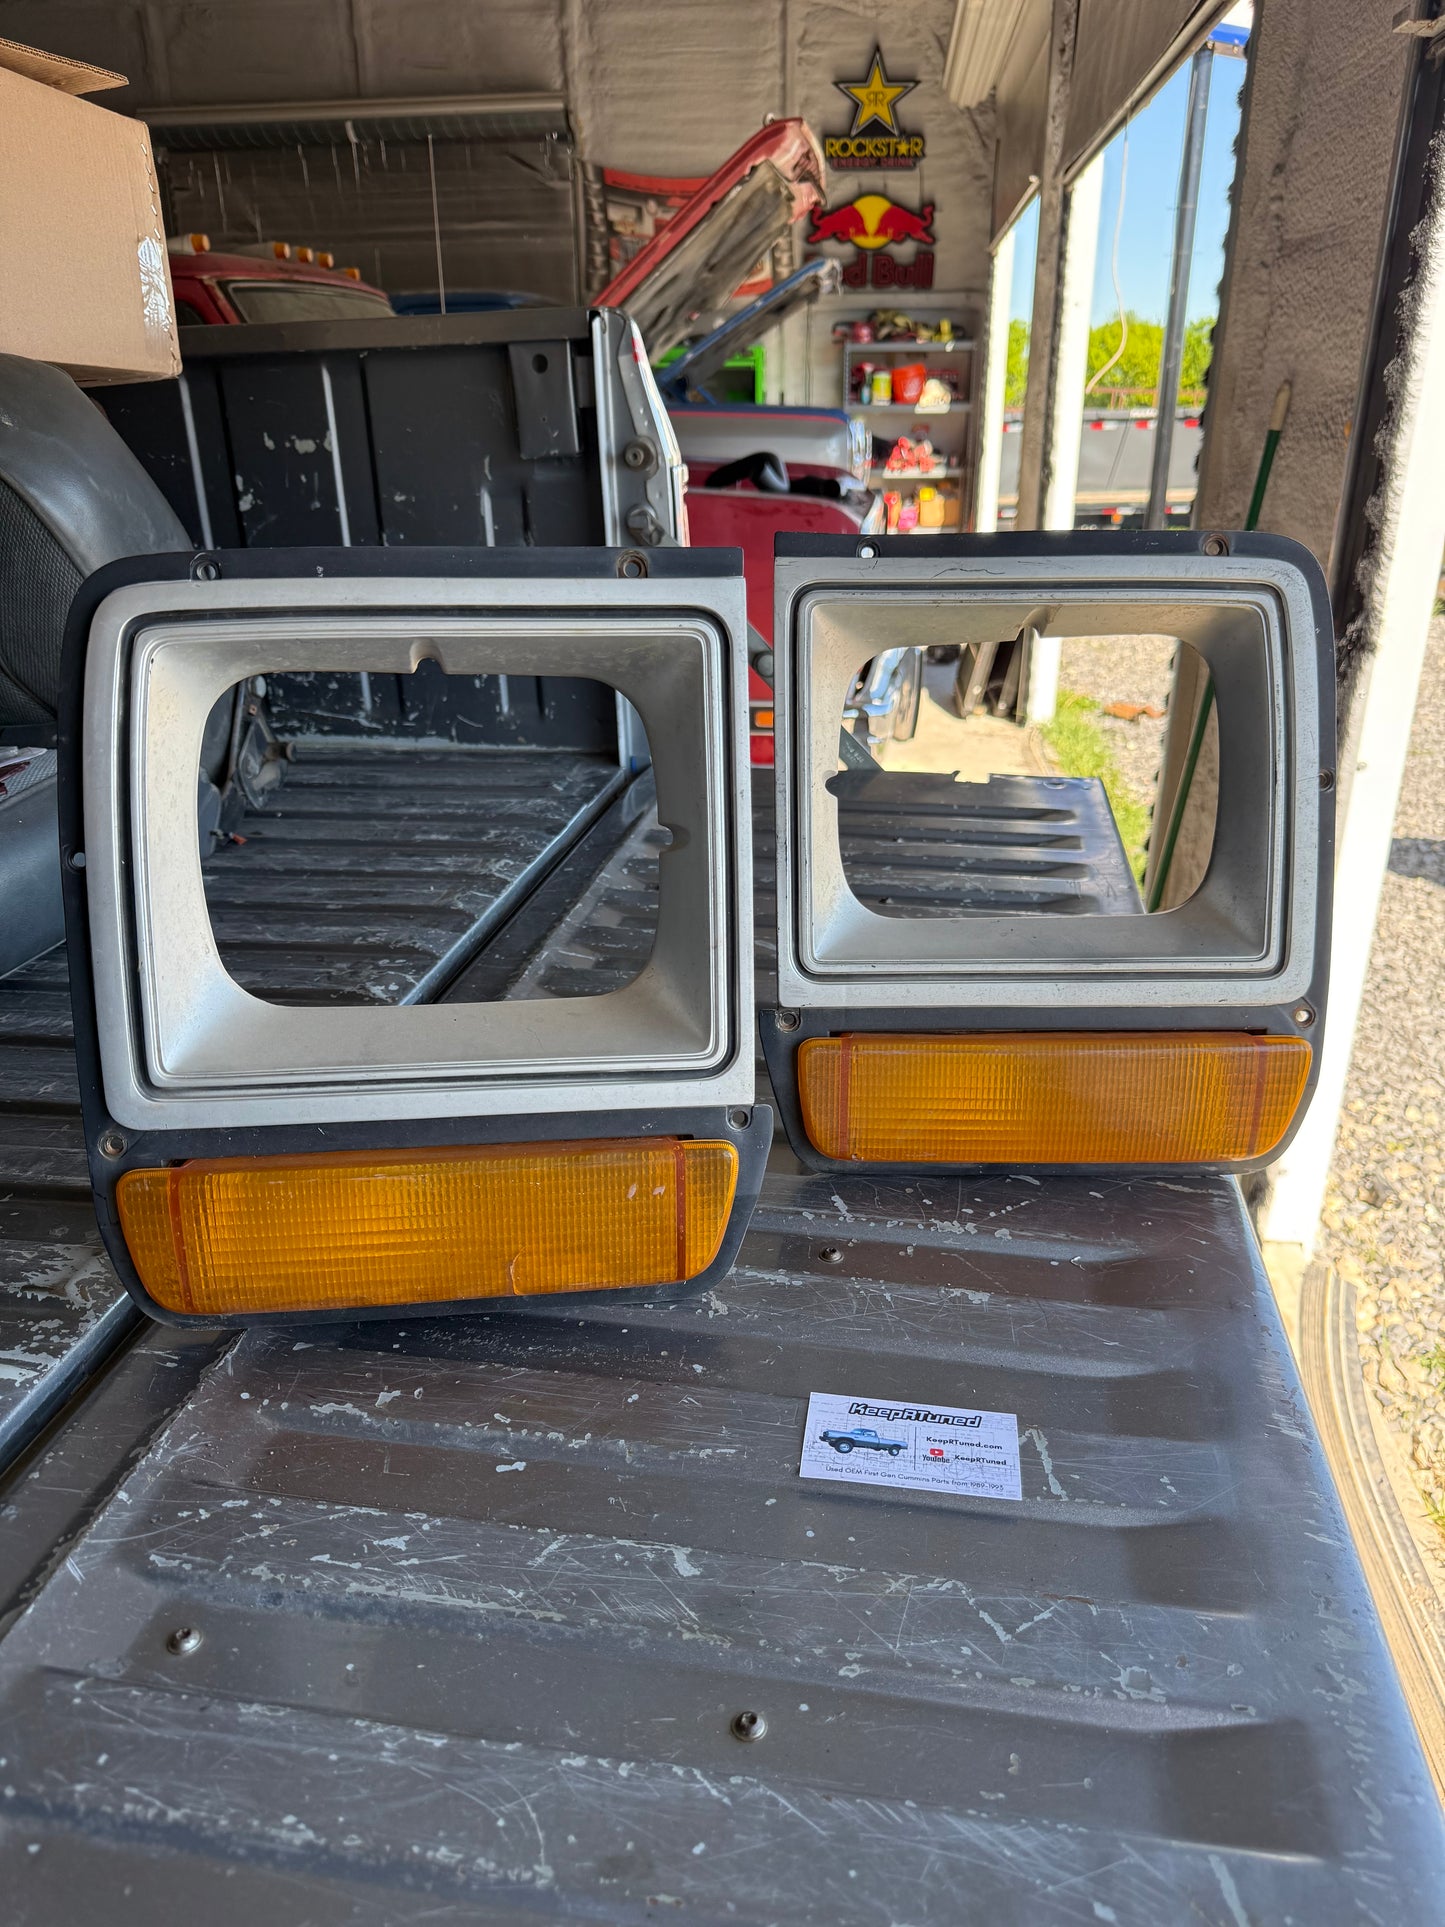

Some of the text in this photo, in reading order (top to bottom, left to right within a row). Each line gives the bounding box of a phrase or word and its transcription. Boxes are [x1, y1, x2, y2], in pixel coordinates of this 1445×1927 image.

[872, 252, 934, 289] Bull
[849, 1402, 982, 1428] KeepRTuned
[926, 1436, 1003, 1450] KeepRTuned.com
[825, 1465, 844, 1473] Used
[844, 1467, 863, 1475] OEM
[864, 1469, 879, 1477] First
[880, 1471, 896, 1479] Gen
[897, 1473, 930, 1483] Cummins
[931, 1477, 950, 1485] Parts
[951, 1479, 968, 1487] from
